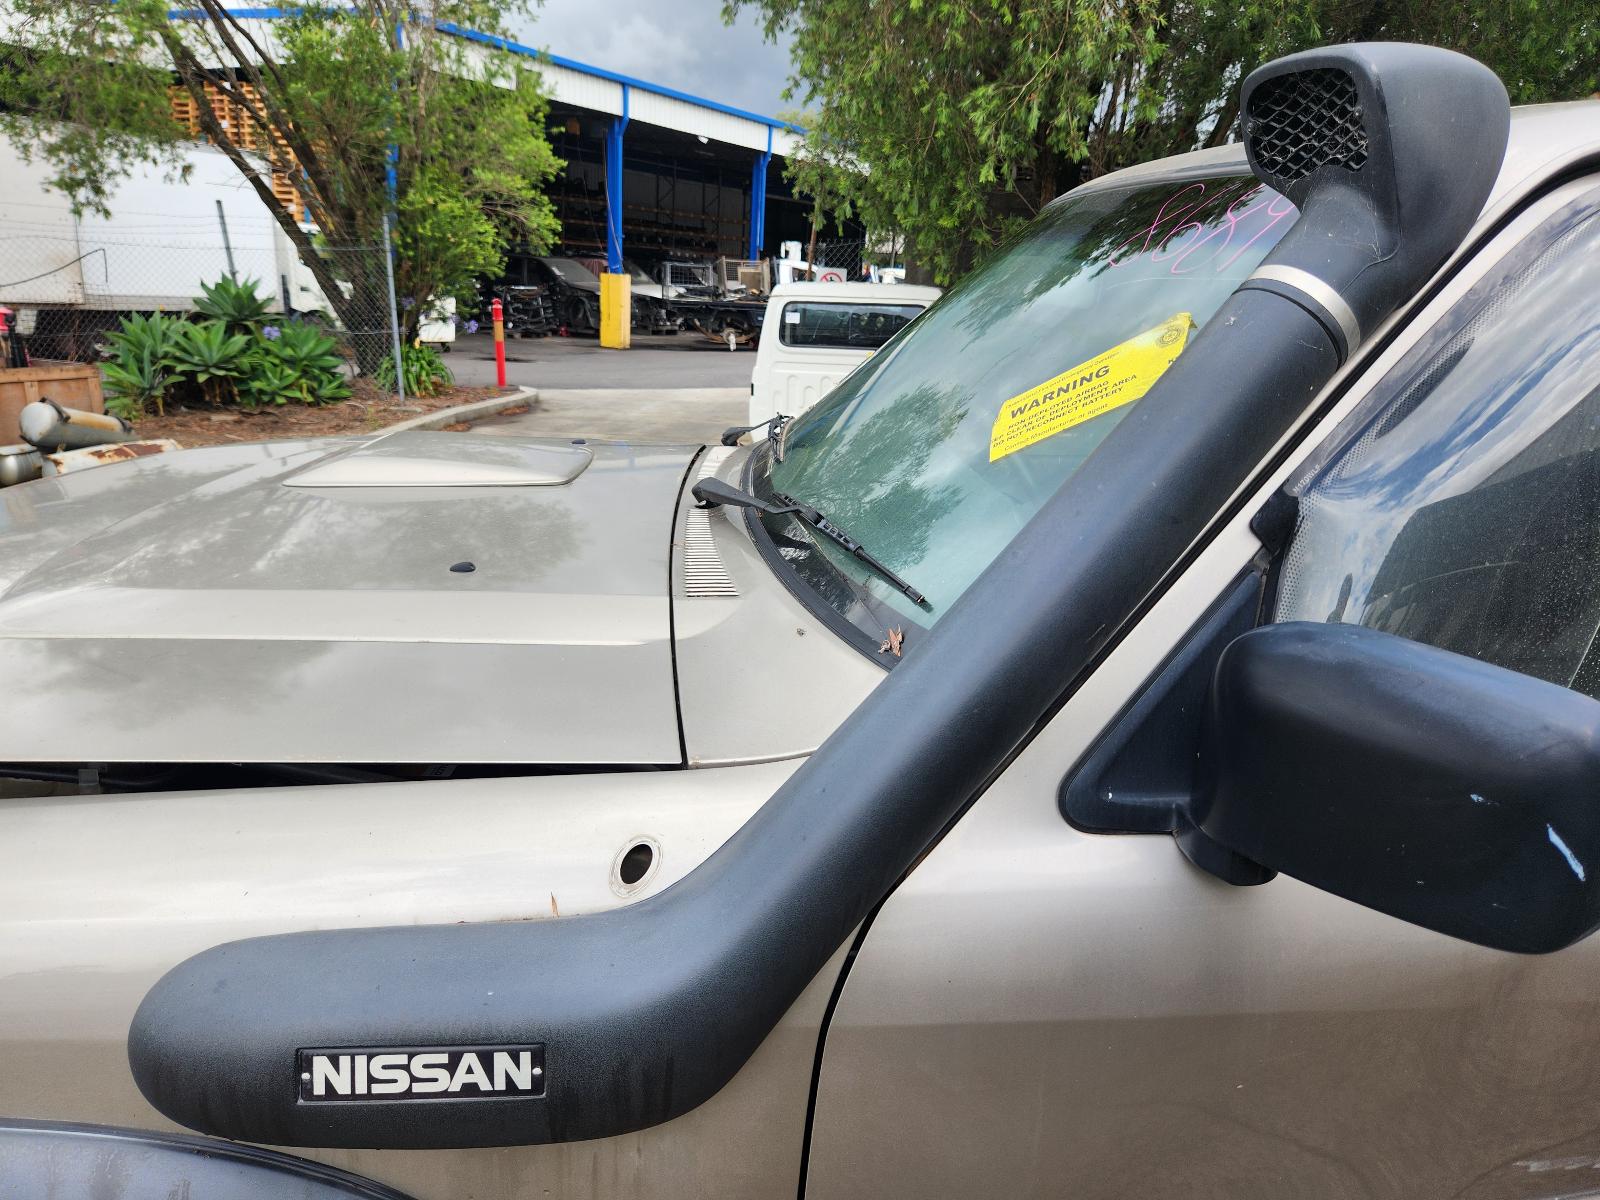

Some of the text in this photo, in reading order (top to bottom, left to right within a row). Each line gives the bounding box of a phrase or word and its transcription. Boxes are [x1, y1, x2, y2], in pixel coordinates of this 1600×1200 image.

[1006, 430, 1024, 442] NOT
[1026, 405, 1079, 433] RECONNECT
[1082, 385, 1123, 408] BATTERY
[1007, 420, 1033, 436] CLEAR
[1049, 386, 1109, 416] DEPLOYMENT
[1111, 374, 1137, 389] AREA
[1011, 365, 1110, 419] WARNING
[1075, 380, 1109, 400] AIRBAG
[312, 1051, 532, 1096] NISSAN
